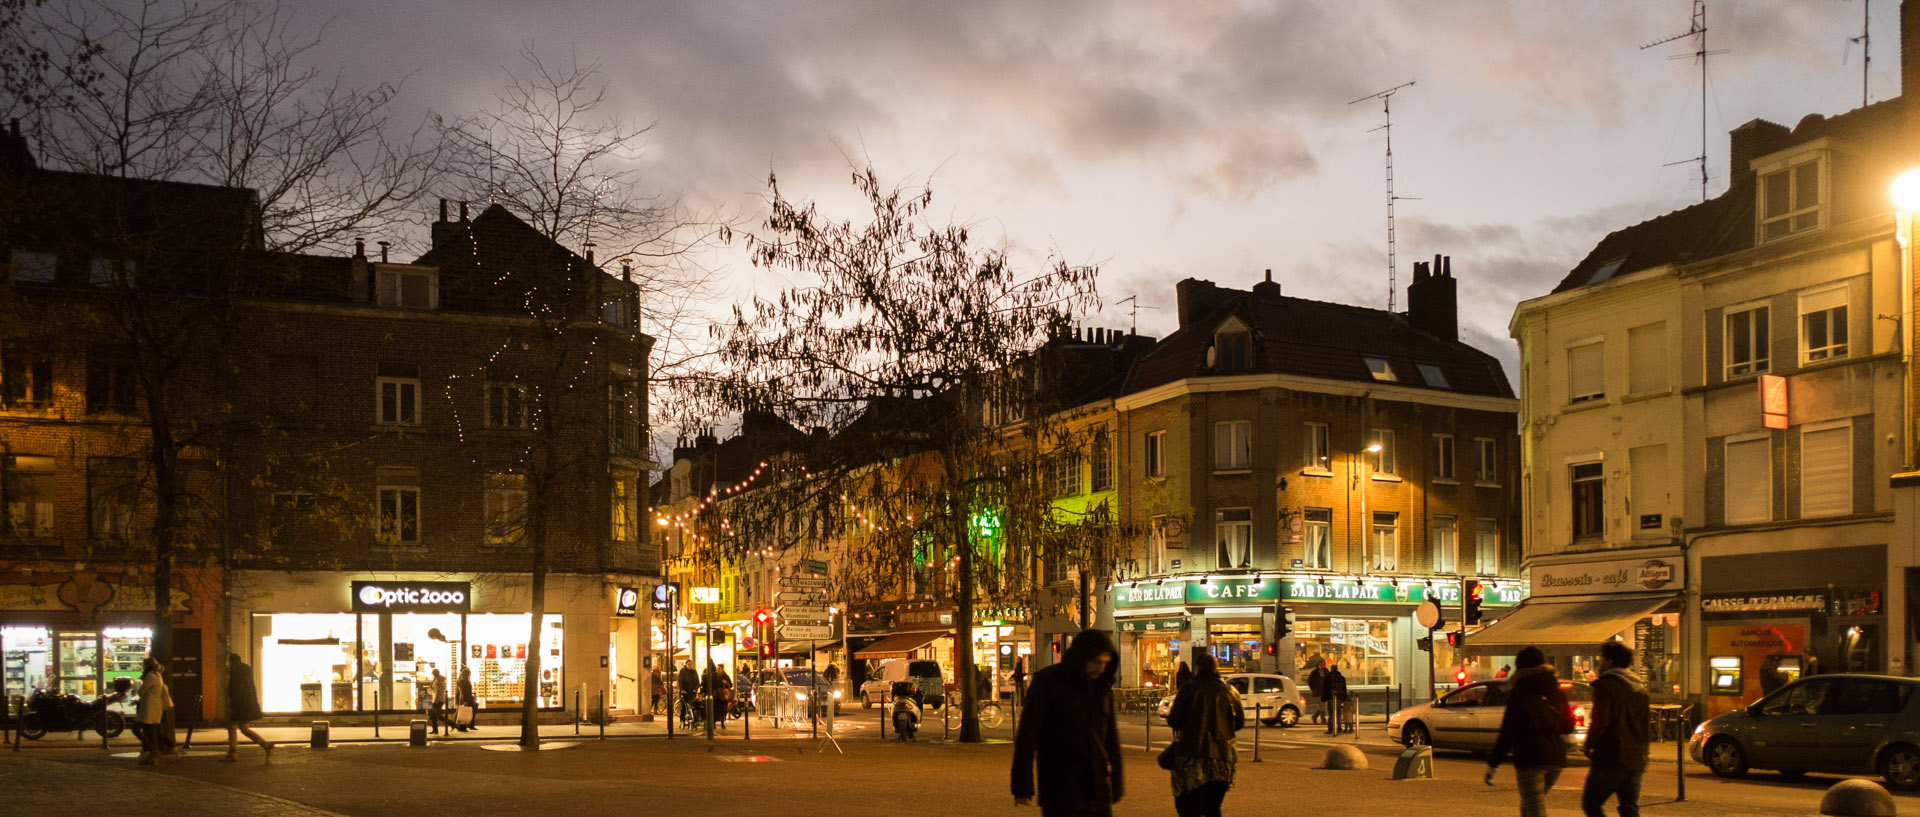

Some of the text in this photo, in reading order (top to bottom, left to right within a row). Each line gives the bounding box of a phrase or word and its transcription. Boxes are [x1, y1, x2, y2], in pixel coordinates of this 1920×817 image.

[1540, 573, 1593, 588] Brasserie
[1602, 569, 1629, 587] café
[373, 587, 465, 608] Optic 2000
[1127, 590, 1143, 602] BAR
[1143, 588, 1154, 602] DE
[1154, 587, 1165, 601] LA
[1165, 586, 1183, 599] PAIX
[1207, 584, 1259, 598] CAFE
[1290, 585, 1379, 600] BAR DE LA PAIX
[1500, 590, 1521, 602] BAR
[1701, 595, 1825, 610] CAISSE D'EPARGNE
[973, 606, 1025, 620] ARMACIE
[1740, 629, 1773, 637] BANQUE
[1730, 639, 1784, 648] AUTOMATIQUE
